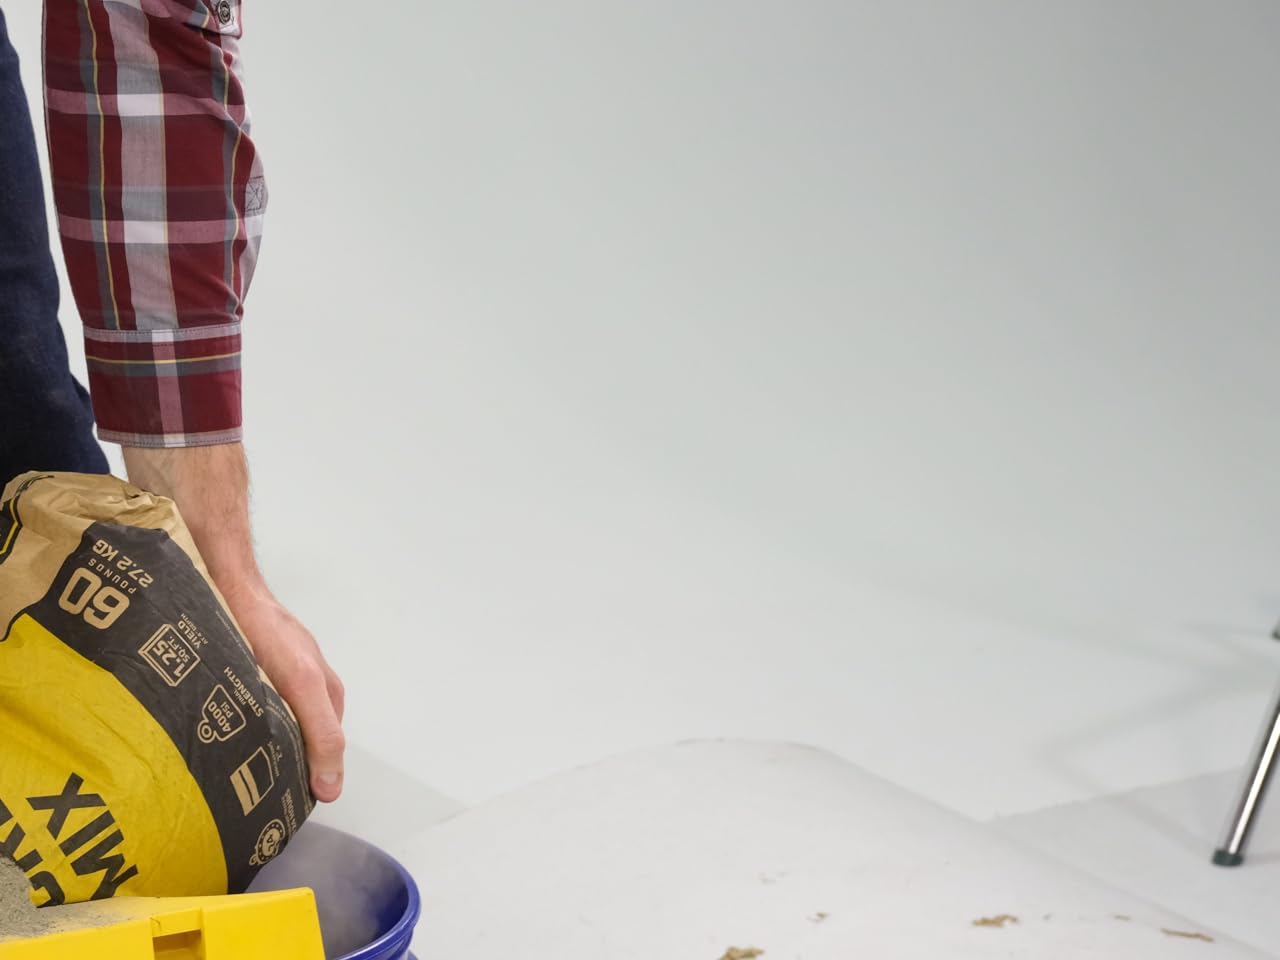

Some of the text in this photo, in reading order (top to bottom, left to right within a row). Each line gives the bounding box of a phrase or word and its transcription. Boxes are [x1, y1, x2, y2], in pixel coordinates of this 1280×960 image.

[88, 558, 137, 594] POUNDS
[92, 539, 154, 588] 27.2 KG
[58, 567, 130, 630] 60
[178, 620, 202, 649] YIELD
[152, 639, 186, 678] 1.25
[224, 666, 265, 717] STRENGTH
[233, 688, 247, 706] FINAL
[207, 701, 231, 732] 4000
[220, 702, 234, 719] PSI
[26, 772, 139, 901] MIX
